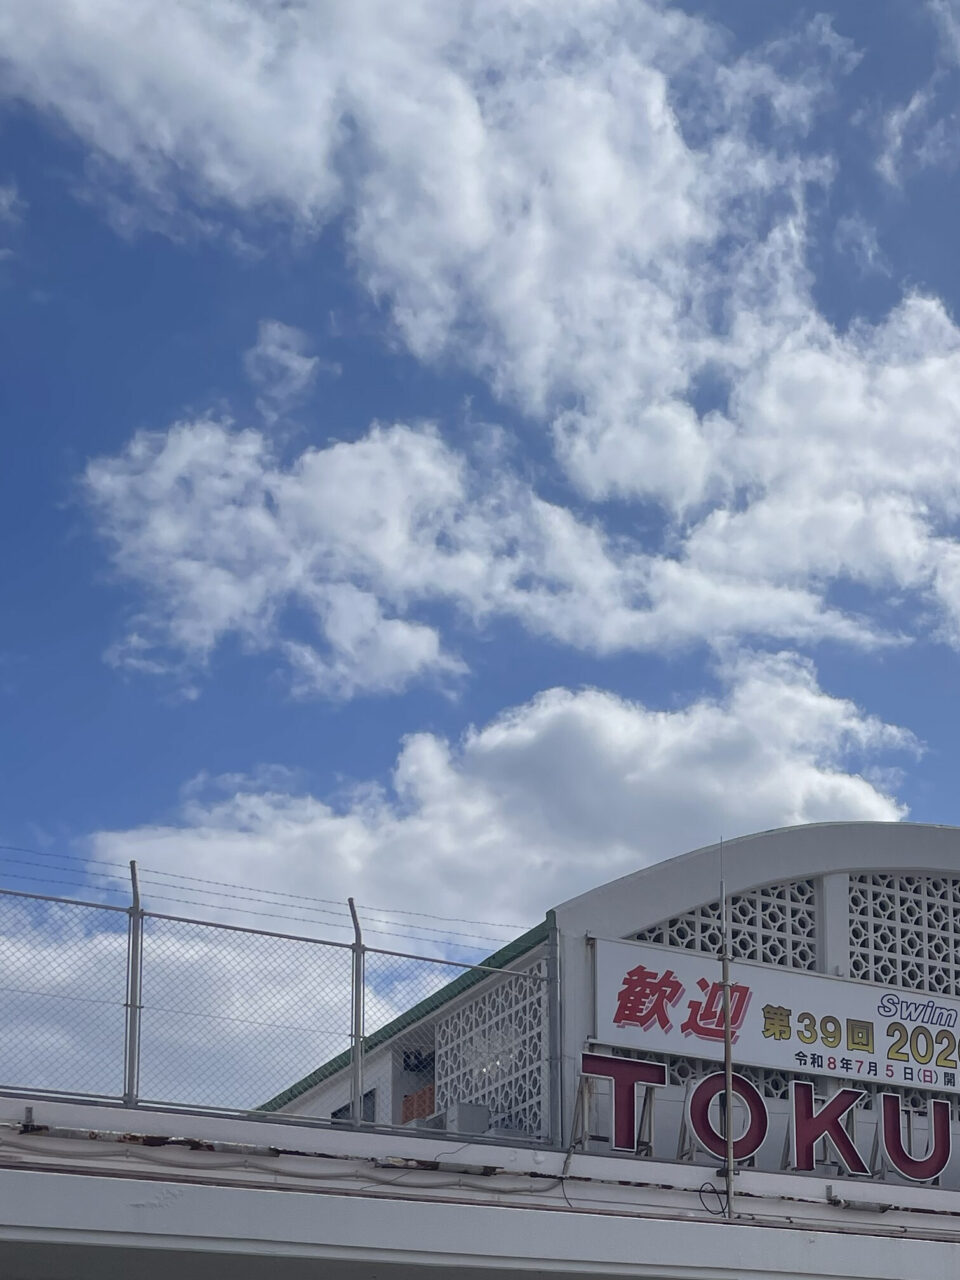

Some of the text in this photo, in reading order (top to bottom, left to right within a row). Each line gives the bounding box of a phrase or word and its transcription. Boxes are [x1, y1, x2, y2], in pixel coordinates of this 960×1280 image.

[612, 964, 754, 1044] 歓迎
[761, 1003, 876, 1055] 第39回
[877, 992, 959, 1028] Swim
